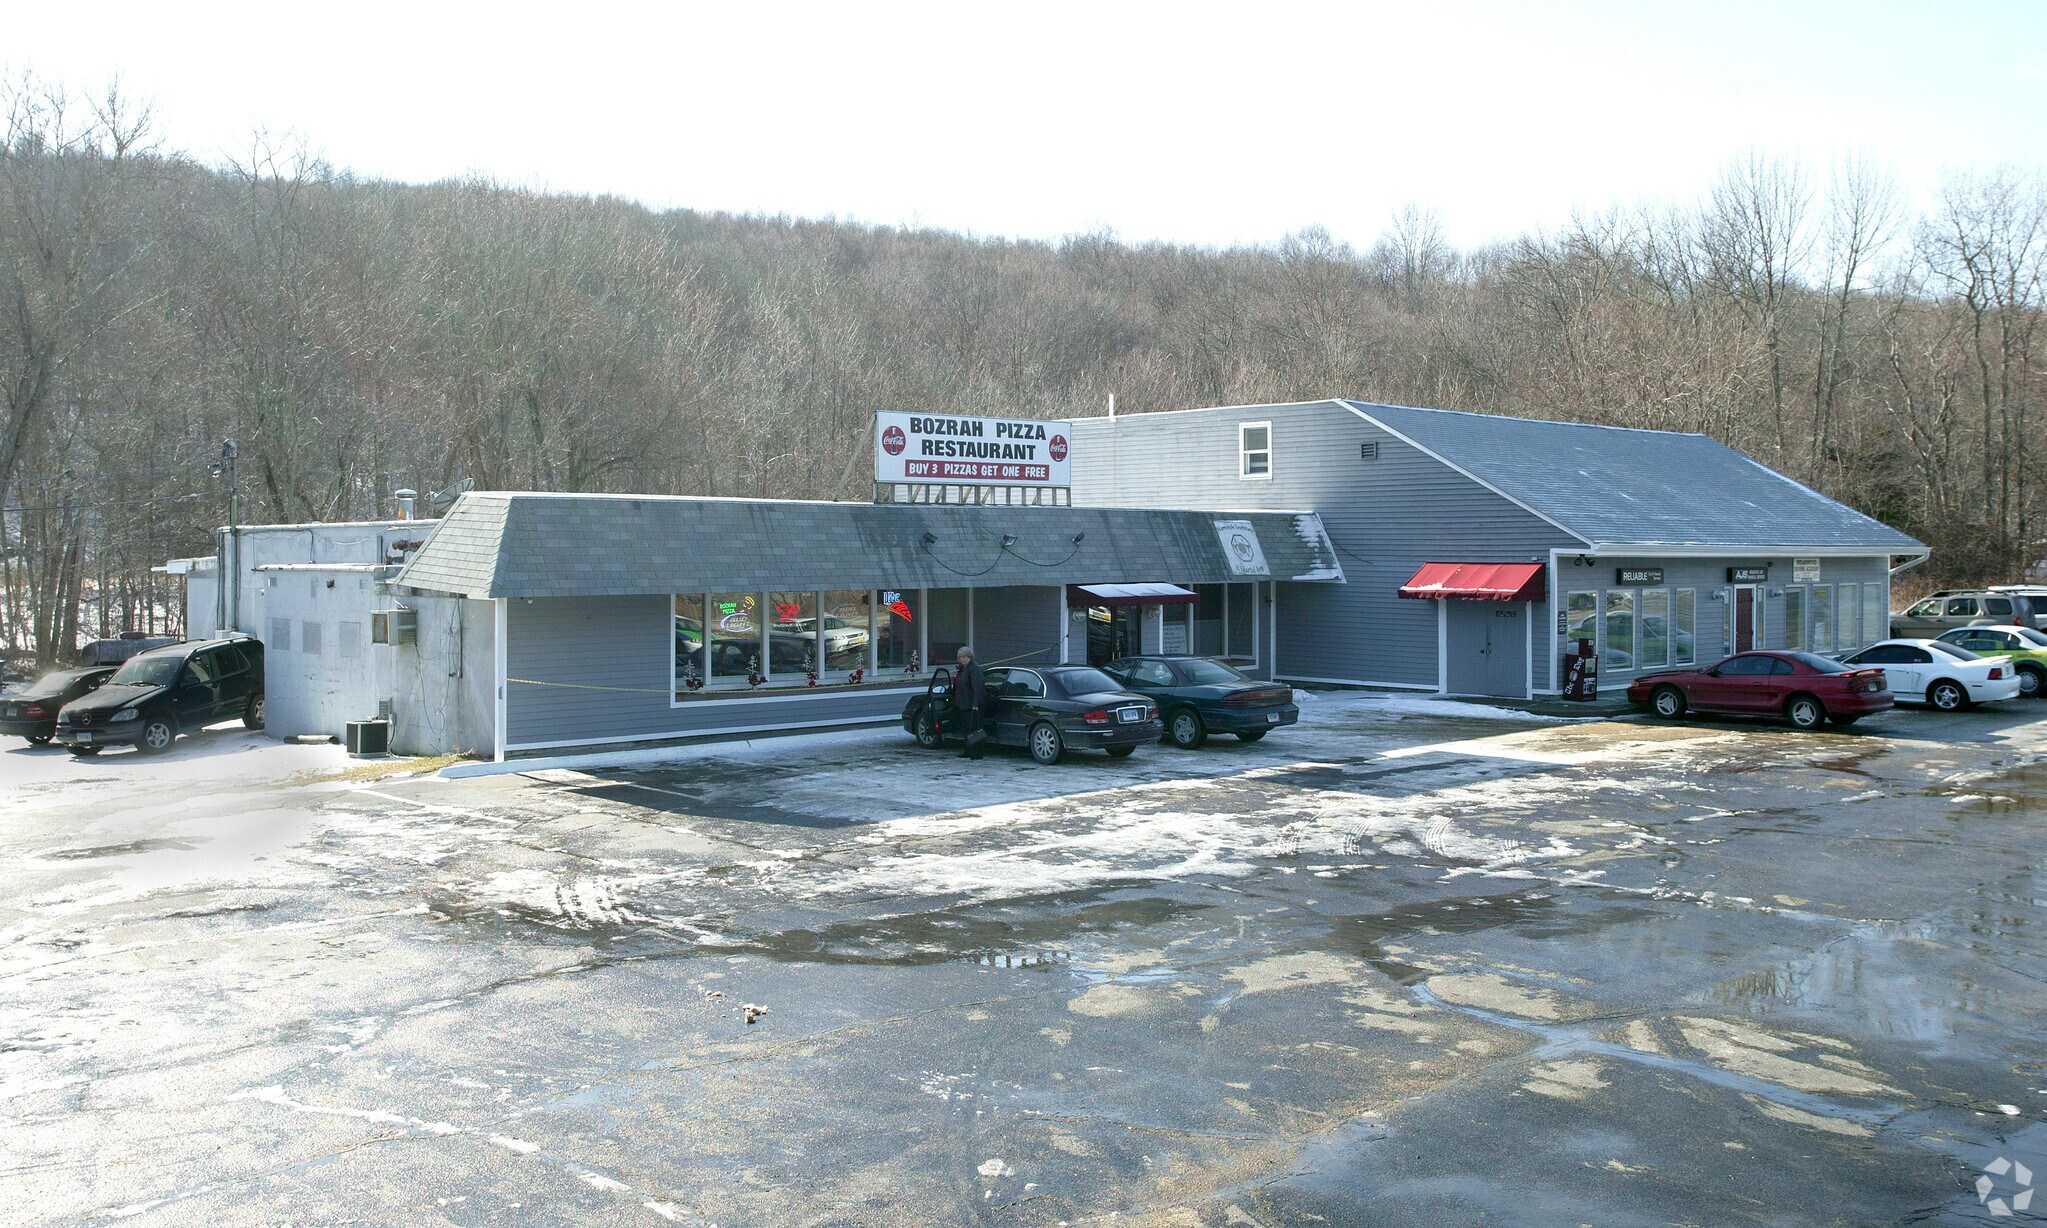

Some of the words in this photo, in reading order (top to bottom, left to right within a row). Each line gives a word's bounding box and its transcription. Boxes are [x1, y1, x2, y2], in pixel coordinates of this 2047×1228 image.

[910, 417, 983, 437] BOZRAH
[996, 422, 1046, 440] PIZZA
[921, 439, 1036, 460] RESTAURANT
[909, 463, 929, 475] BUY
[932, 464, 938, 475] 3
[944, 463, 977, 476] PIZZAS
[981, 465, 998, 477] GET
[1002, 466, 1020, 477] ONE
[1025, 466, 1046, 478] FREE
[1623, 571, 1648, 580] RELIABLE
[725, 621, 752, 629] LIGHT
